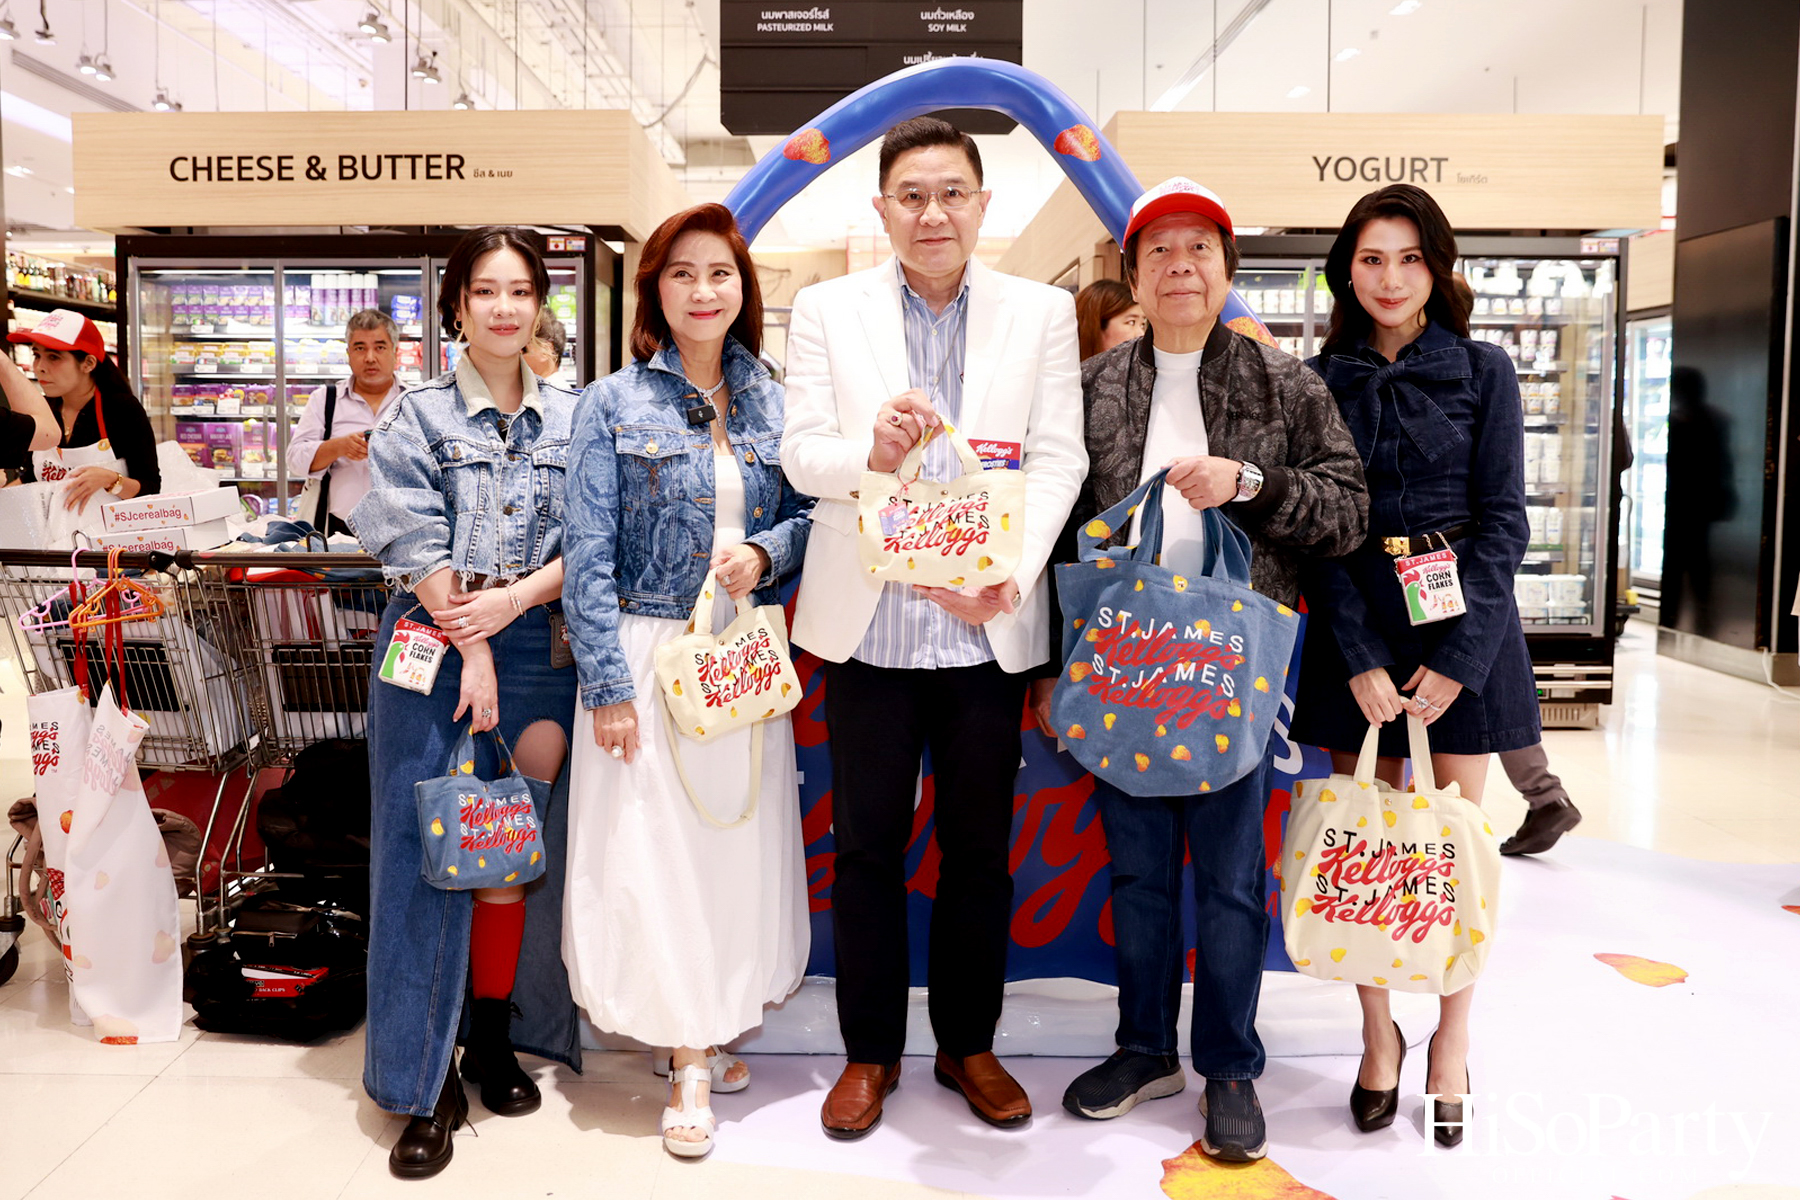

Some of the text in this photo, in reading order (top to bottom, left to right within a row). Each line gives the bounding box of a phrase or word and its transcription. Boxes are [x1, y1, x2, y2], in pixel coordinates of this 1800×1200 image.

[756, 22, 834, 32] PASTEURIZED MILK
[928, 23, 967, 33] SOY MILK
[169, 153, 466, 182] CHEESE & BUTTER
[487, 169, 496, 179] &
[1312, 156, 1449, 183] YOGURT
[976, 442, 1013, 457] Kellogg's
[114, 508, 182, 522] #SJcerealbag
[102, 541, 174, 552] #Scerealbag
[883, 522, 990, 557] Kellogg's
[1404, 552, 1448, 567] ST.JAMES
[1426, 571, 1452, 583] CORN
[1428, 580, 1454, 591] FLAKES
[403, 621, 443, 638] ST.JAMES
[412, 642, 437, 656] CORN
[1093, 619, 1241, 672] Kellogg's
[408, 650, 434, 664] FLAKES
[704, 655, 782, 708] Kellogg's
[1087, 674, 1233, 730] Kellogg's
[459, 798, 533, 829] Kellogg's
[459, 823, 538, 855] Kellogg's
[1323, 828, 1456, 859] ST.JAMES
[1317, 839, 1456, 888] Kellogg's
[1315, 873, 1456, 907] ST.JAMES
[1311, 893, 1456, 944] Kellogg's
